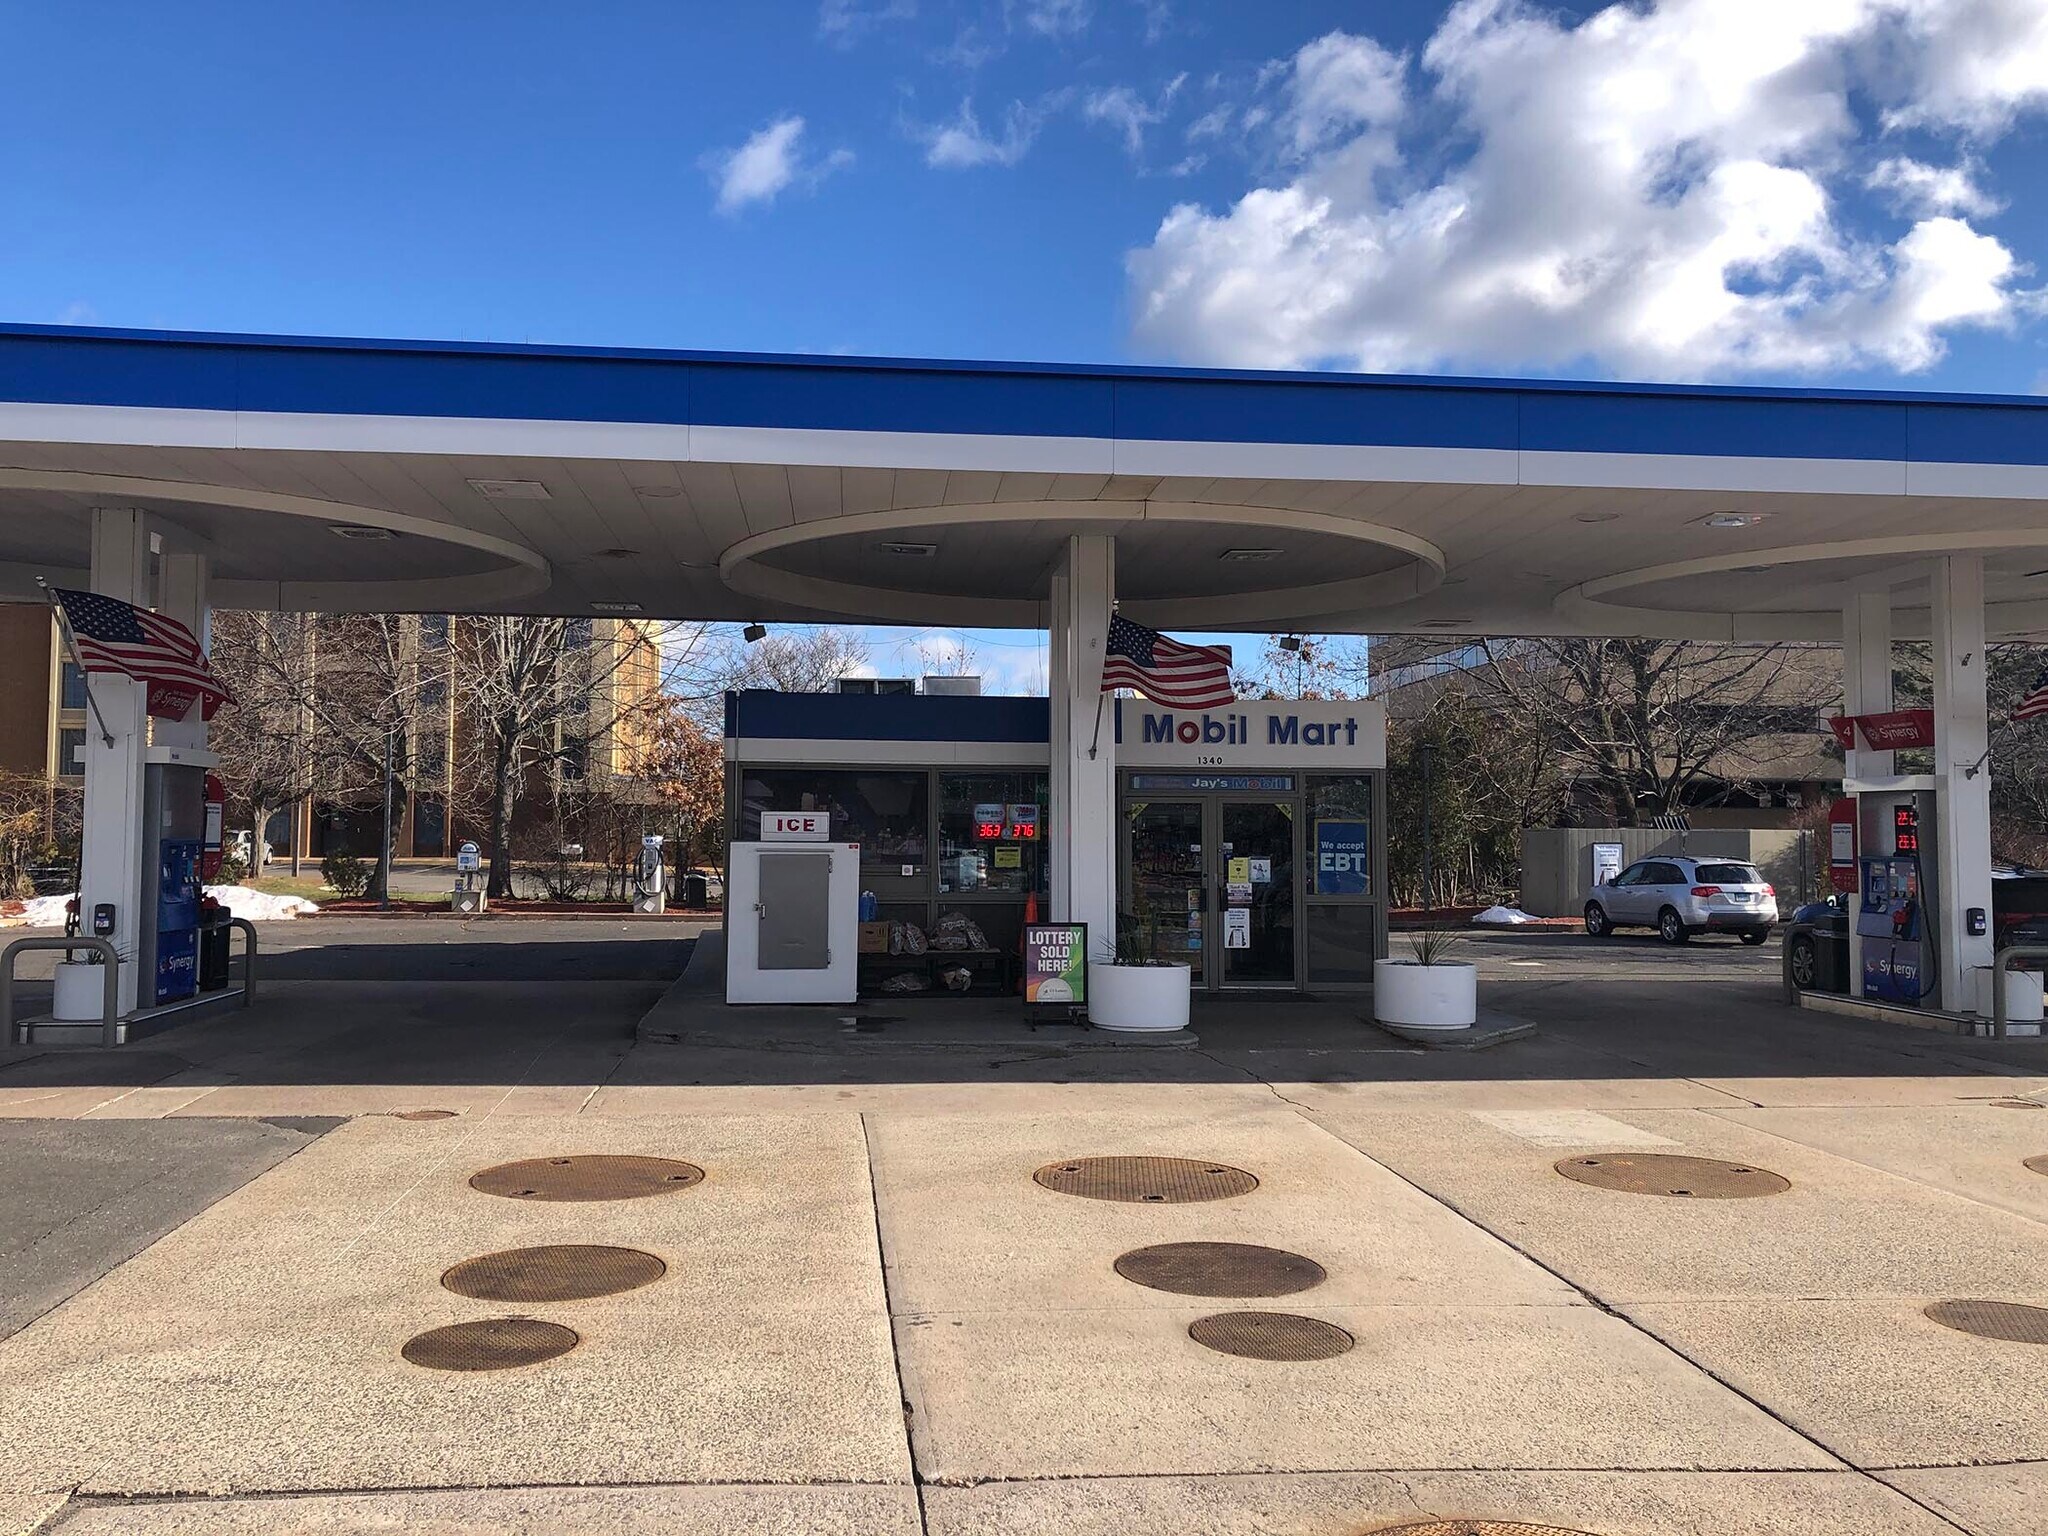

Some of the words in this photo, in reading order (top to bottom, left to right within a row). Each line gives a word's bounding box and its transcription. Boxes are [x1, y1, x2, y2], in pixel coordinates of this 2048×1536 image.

[1143, 714, 1247, 744] Mobil
[1267, 715, 1358, 745] Mart
[1843, 726, 1851, 737] 4
[1879, 726, 1919, 740] Synergy
[1197, 756, 1223, 765] 1340
[1191, 778, 1228, 789] Jay's
[1232, 777, 1281, 789] Mobil
[777, 818, 815, 832] ICE
[979, 824, 1001, 837] 363
[1013, 824, 1034, 838] 376
[1320, 841, 1334, 849] We
[1336, 842, 1365, 851] accept
[1320, 852, 1366, 872] EBT
[1029, 931, 1081, 945] LOTTERY
[1040, 945, 1070, 958] SOLD
[169, 955, 194, 973] Synergy
[1037, 960, 1072, 972] HERE!
